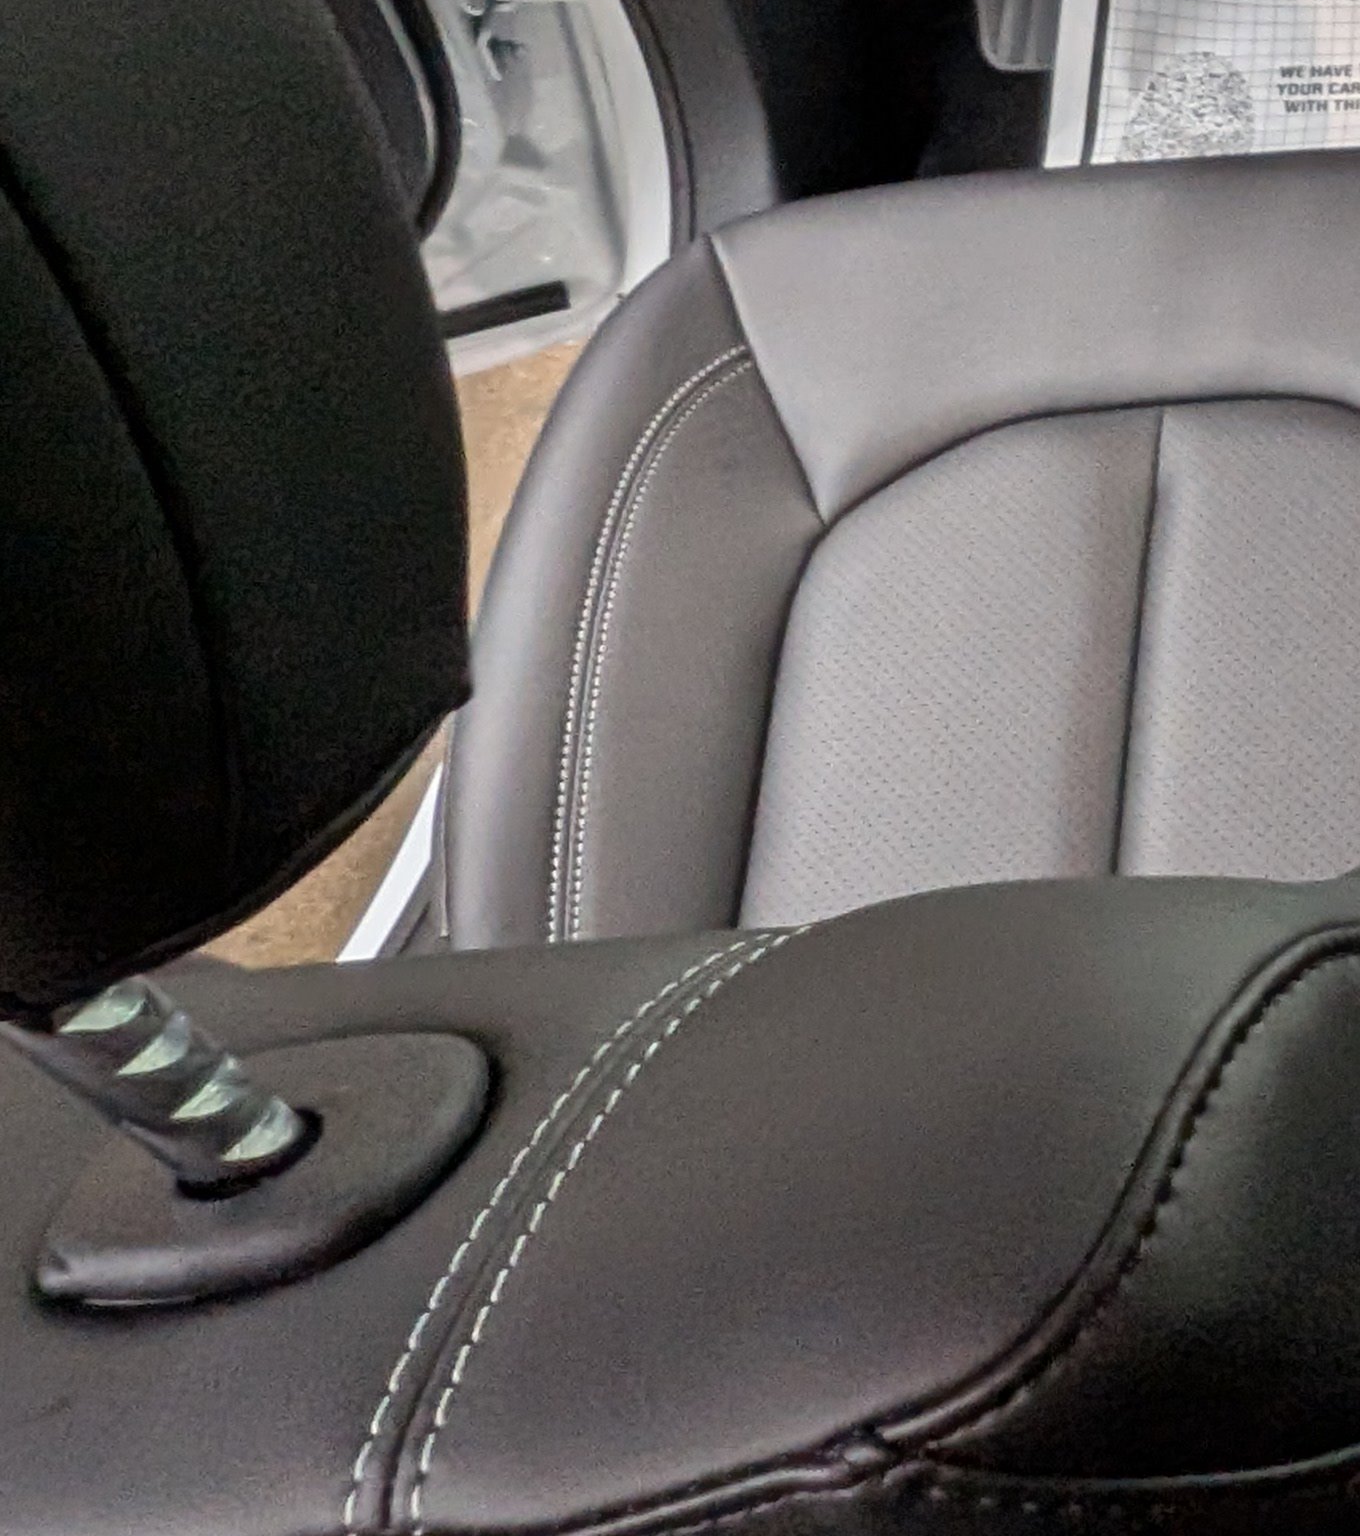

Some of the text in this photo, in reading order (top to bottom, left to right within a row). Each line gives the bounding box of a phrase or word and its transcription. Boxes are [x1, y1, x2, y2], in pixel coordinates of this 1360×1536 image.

[1280, 66, 1304, 79] WE
[1310, 64, 1352, 78] HAVE
[1277, 82, 1323, 96] YOUR
[1283, 99, 1328, 113] WITH
